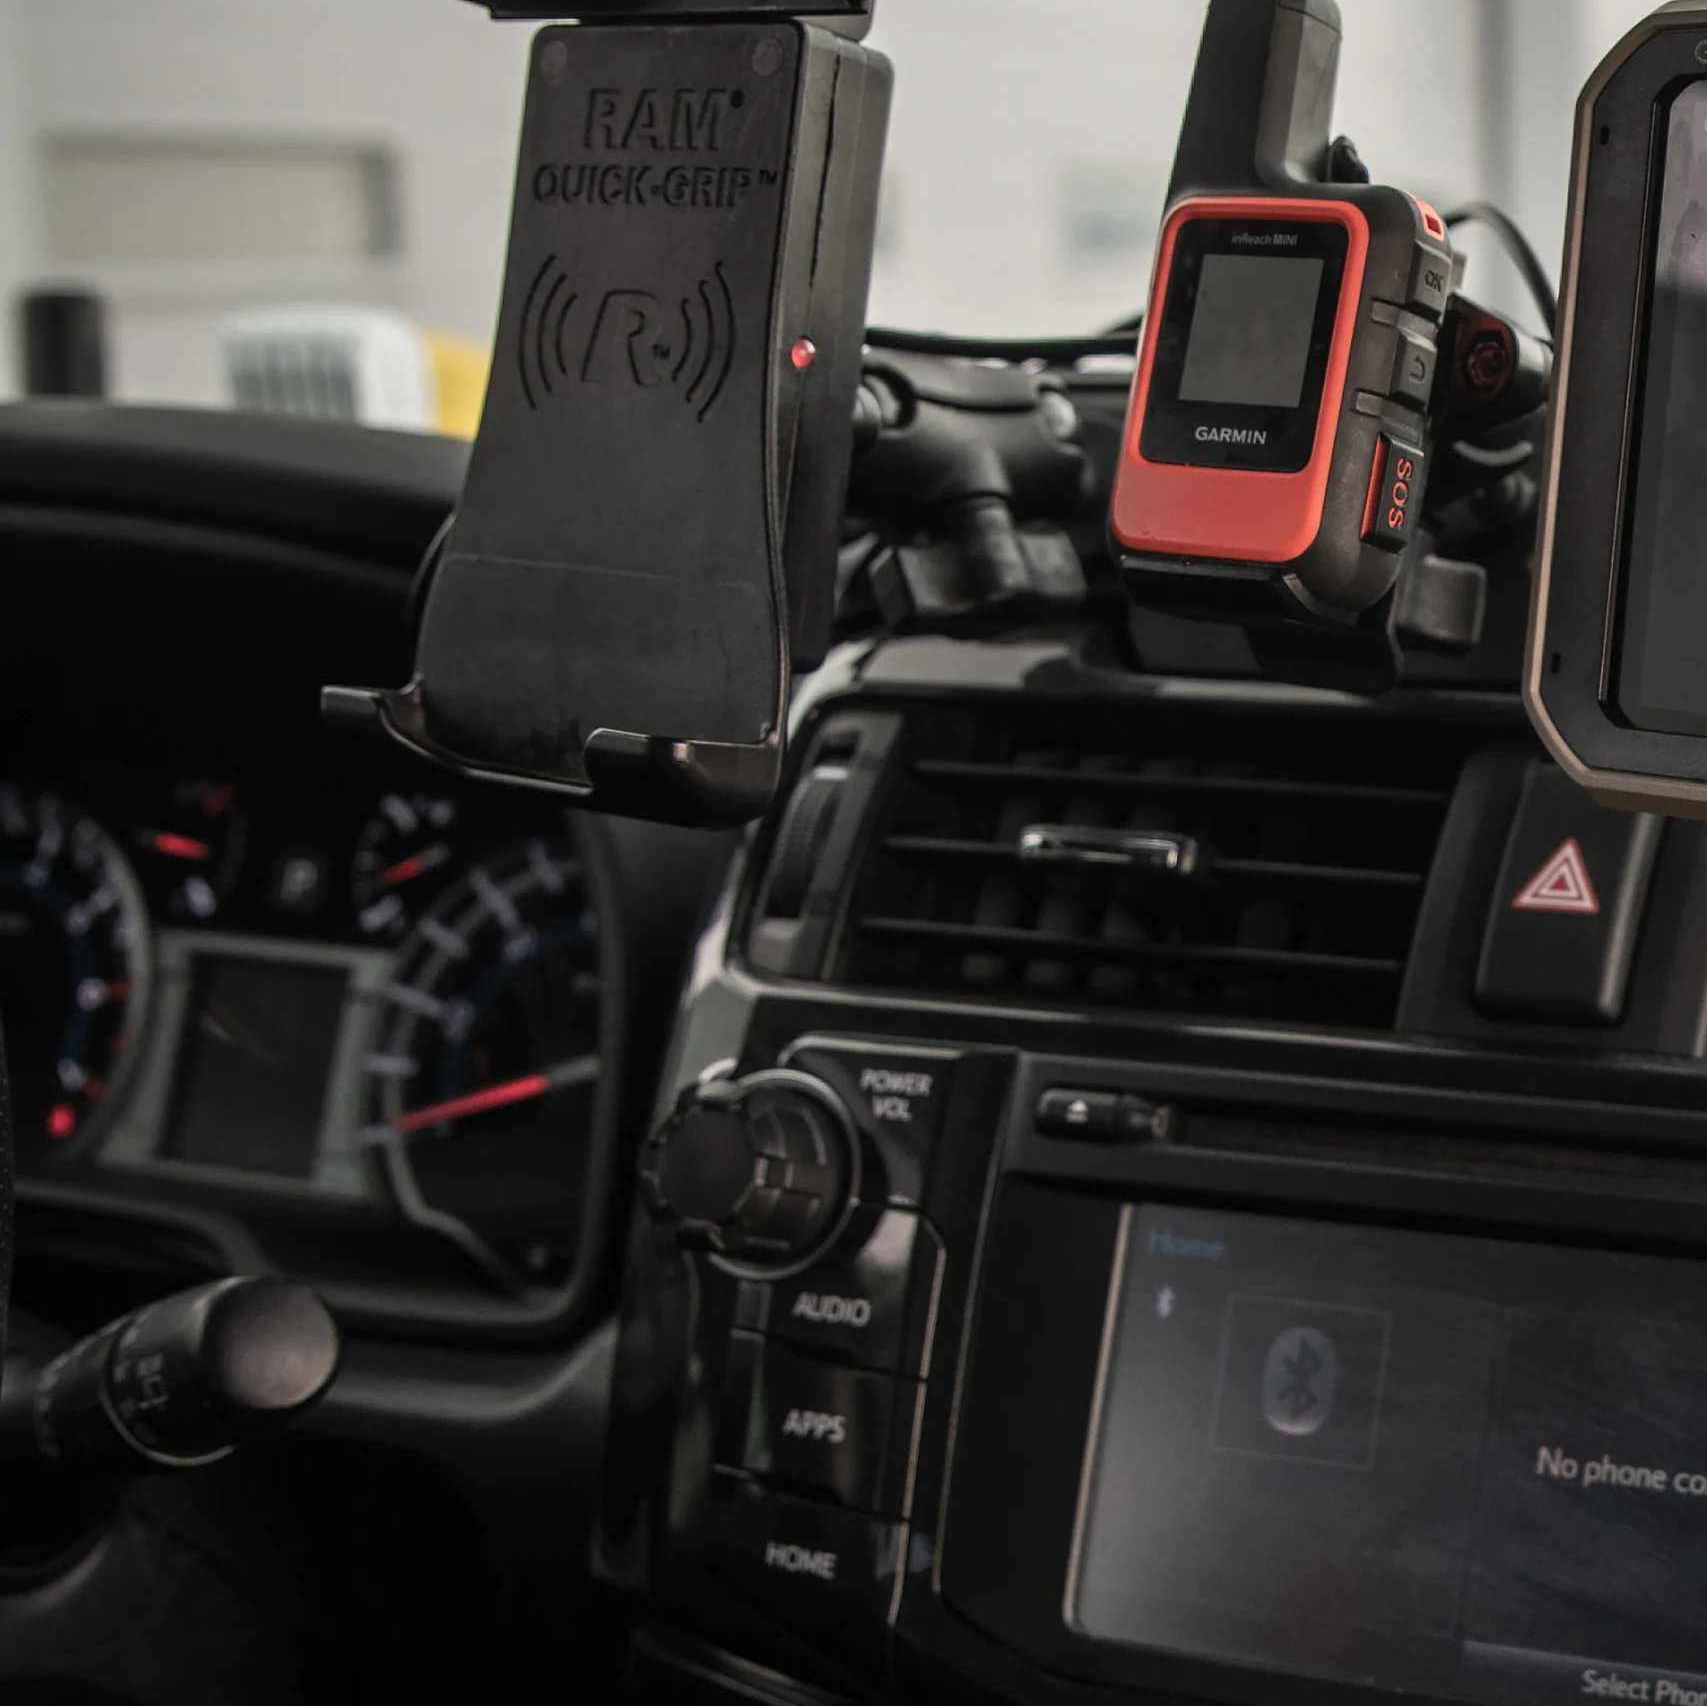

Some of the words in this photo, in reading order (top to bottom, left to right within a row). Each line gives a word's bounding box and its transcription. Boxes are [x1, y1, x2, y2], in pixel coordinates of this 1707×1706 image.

[1231, 231, 1272, 246] inReach
[1272, 233, 1298, 246] MINI
[1425, 269, 1444, 293] OK
[1194, 425, 1267, 445] GARMIN
[1388, 458, 1413, 529] SOS
[860, 1068, 934, 1097] POWER
[872, 1094, 913, 1123] VOL
[791, 1291, 872, 1327] AUDIO
[781, 1407, 847, 1444] APPS
[1535, 1445, 1578, 1480] No
[1581, 1454, 1667, 1492] phone
[764, 1540, 838, 1581] HOME
[1580, 1668, 1650, 1703] Select
